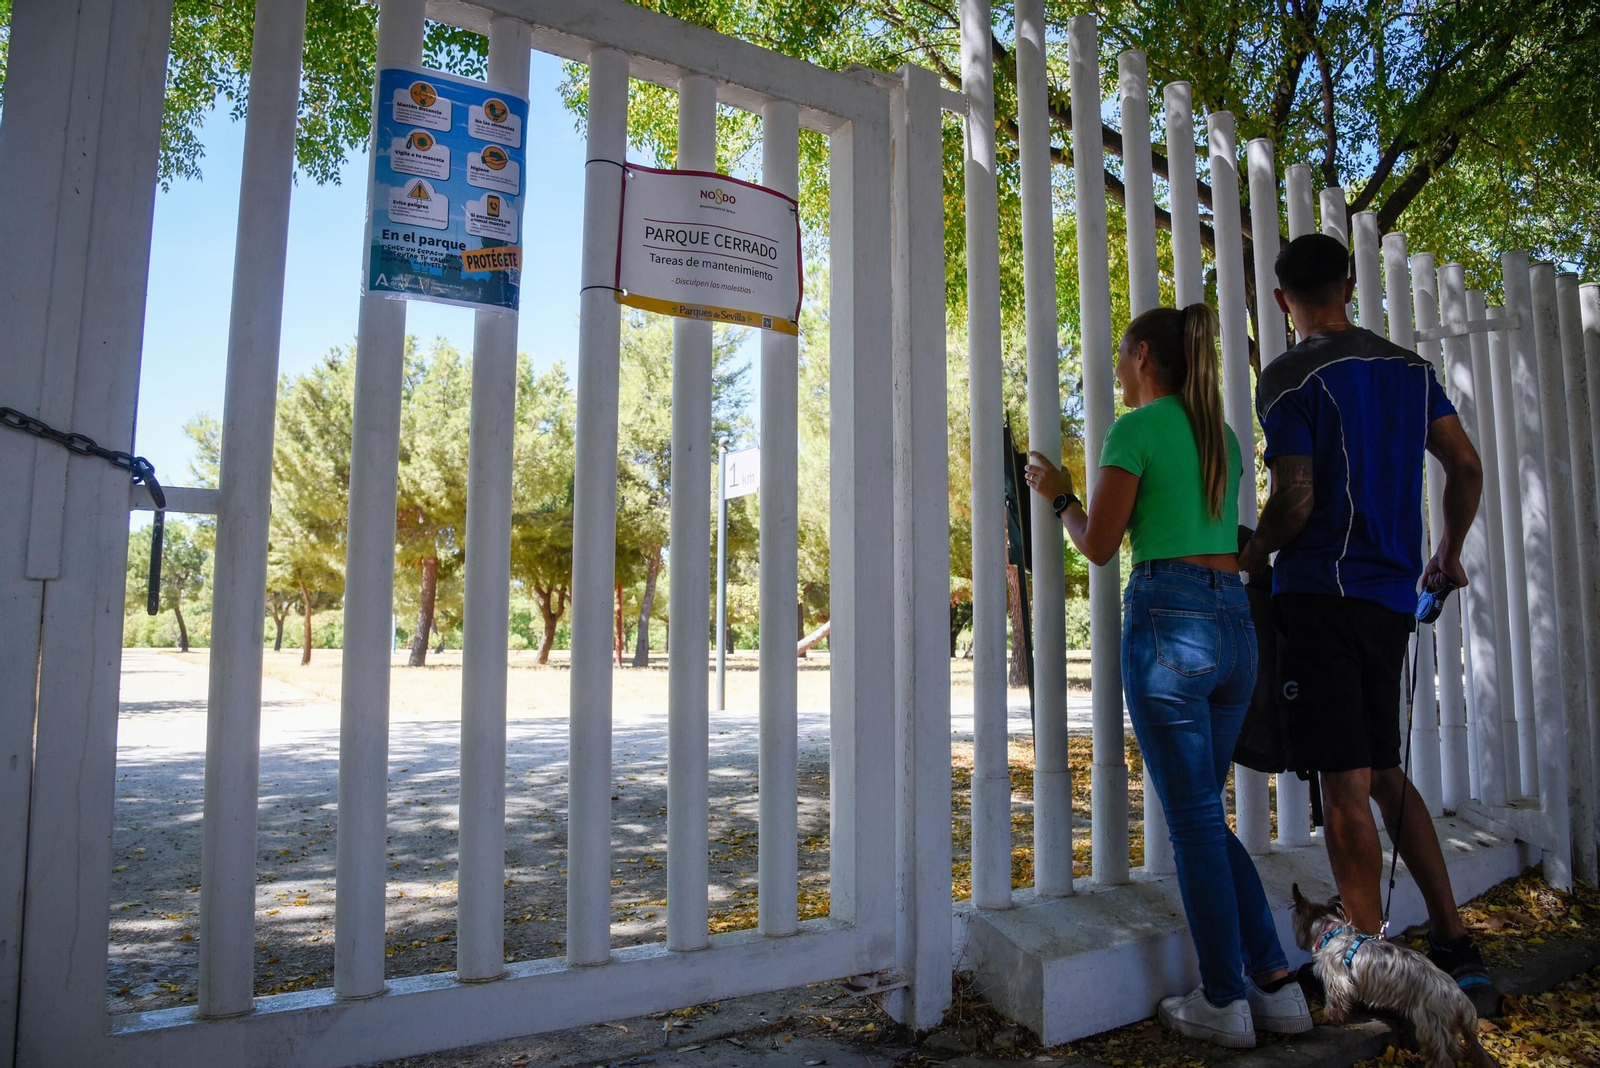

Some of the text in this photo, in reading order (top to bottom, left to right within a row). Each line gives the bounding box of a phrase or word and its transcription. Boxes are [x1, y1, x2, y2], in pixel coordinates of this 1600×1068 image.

[418, 106, 442, 114] distancia
[491, 122, 515, 132] alimentes
[382, 229, 466, 251] En el parque
[645, 226, 778, 260] PARQUE CERRADO
[466, 249, 517, 270] PROTÉGETE
[650, 253, 773, 281] Tareas de mantenimiento
[675, 278, 709, 288] Disculpen
[721, 284, 752, 294] molestias
[680, 305, 713, 318] Parques
[721, 310, 745, 322] Sevilla
[730, 462, 755, 488] 1 km
